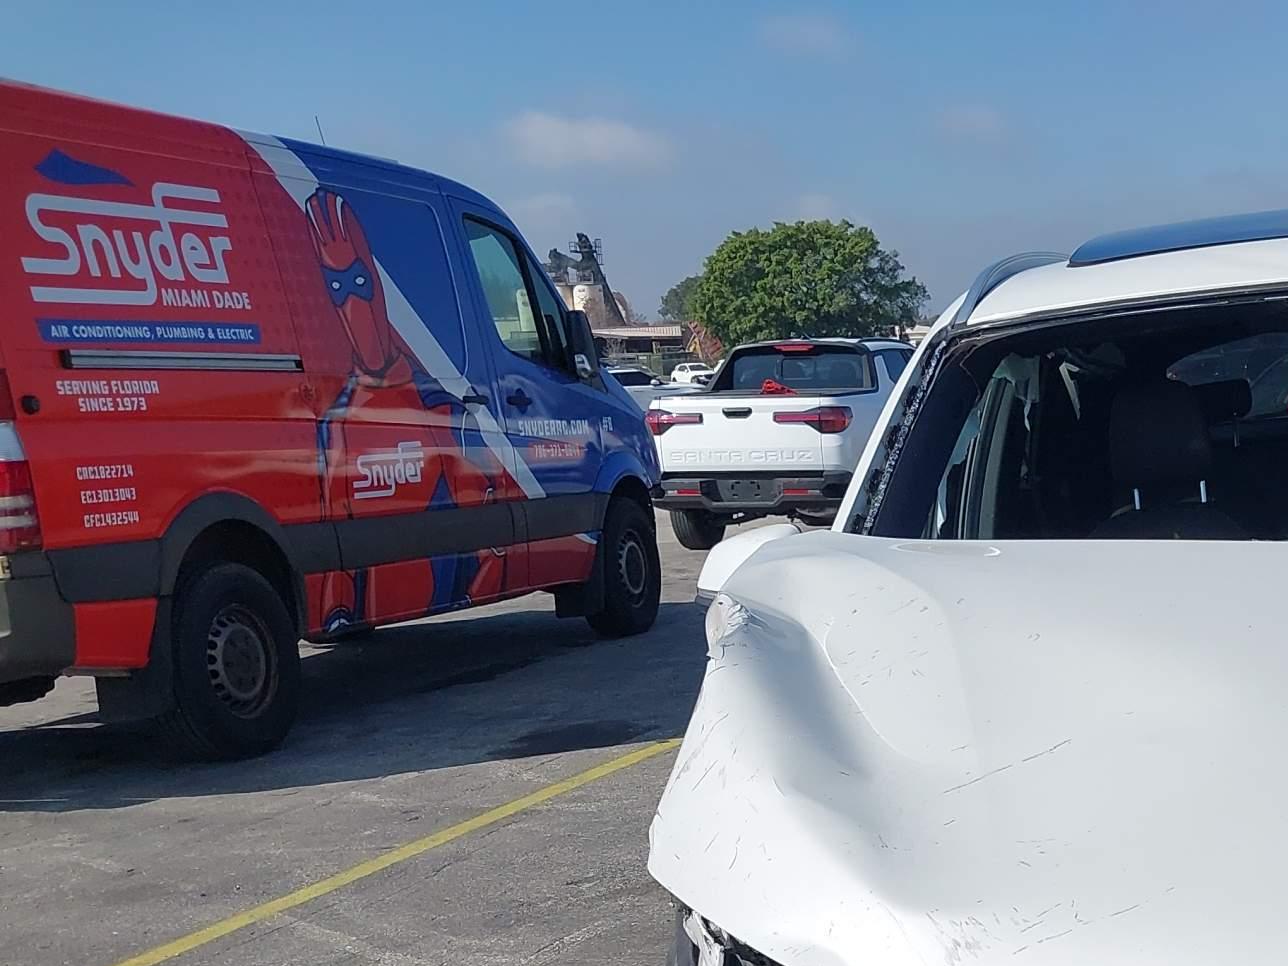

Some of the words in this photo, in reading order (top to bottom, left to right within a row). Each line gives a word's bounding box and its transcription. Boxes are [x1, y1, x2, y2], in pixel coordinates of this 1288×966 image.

[20, 181, 233, 305] Snyder
[162, 288, 210, 309] MIAMI
[213, 291, 252, 310] DADE
[51, 325, 69, 338] AIR
[156, 327, 205, 339] PLUMBING
[207, 328, 215, 339] &
[216, 328, 255, 340] ELECTRIC
[56, 380, 109, 395] SERVING
[111, 380, 160, 394] FLORIDA
[78, 397, 115, 412] SINCE
[116, 397, 147, 411] 1973
[670, 450, 745, 464] SANTA
[749, 449, 815, 462] CRUZ
[353, 441, 424, 499] Snyder
